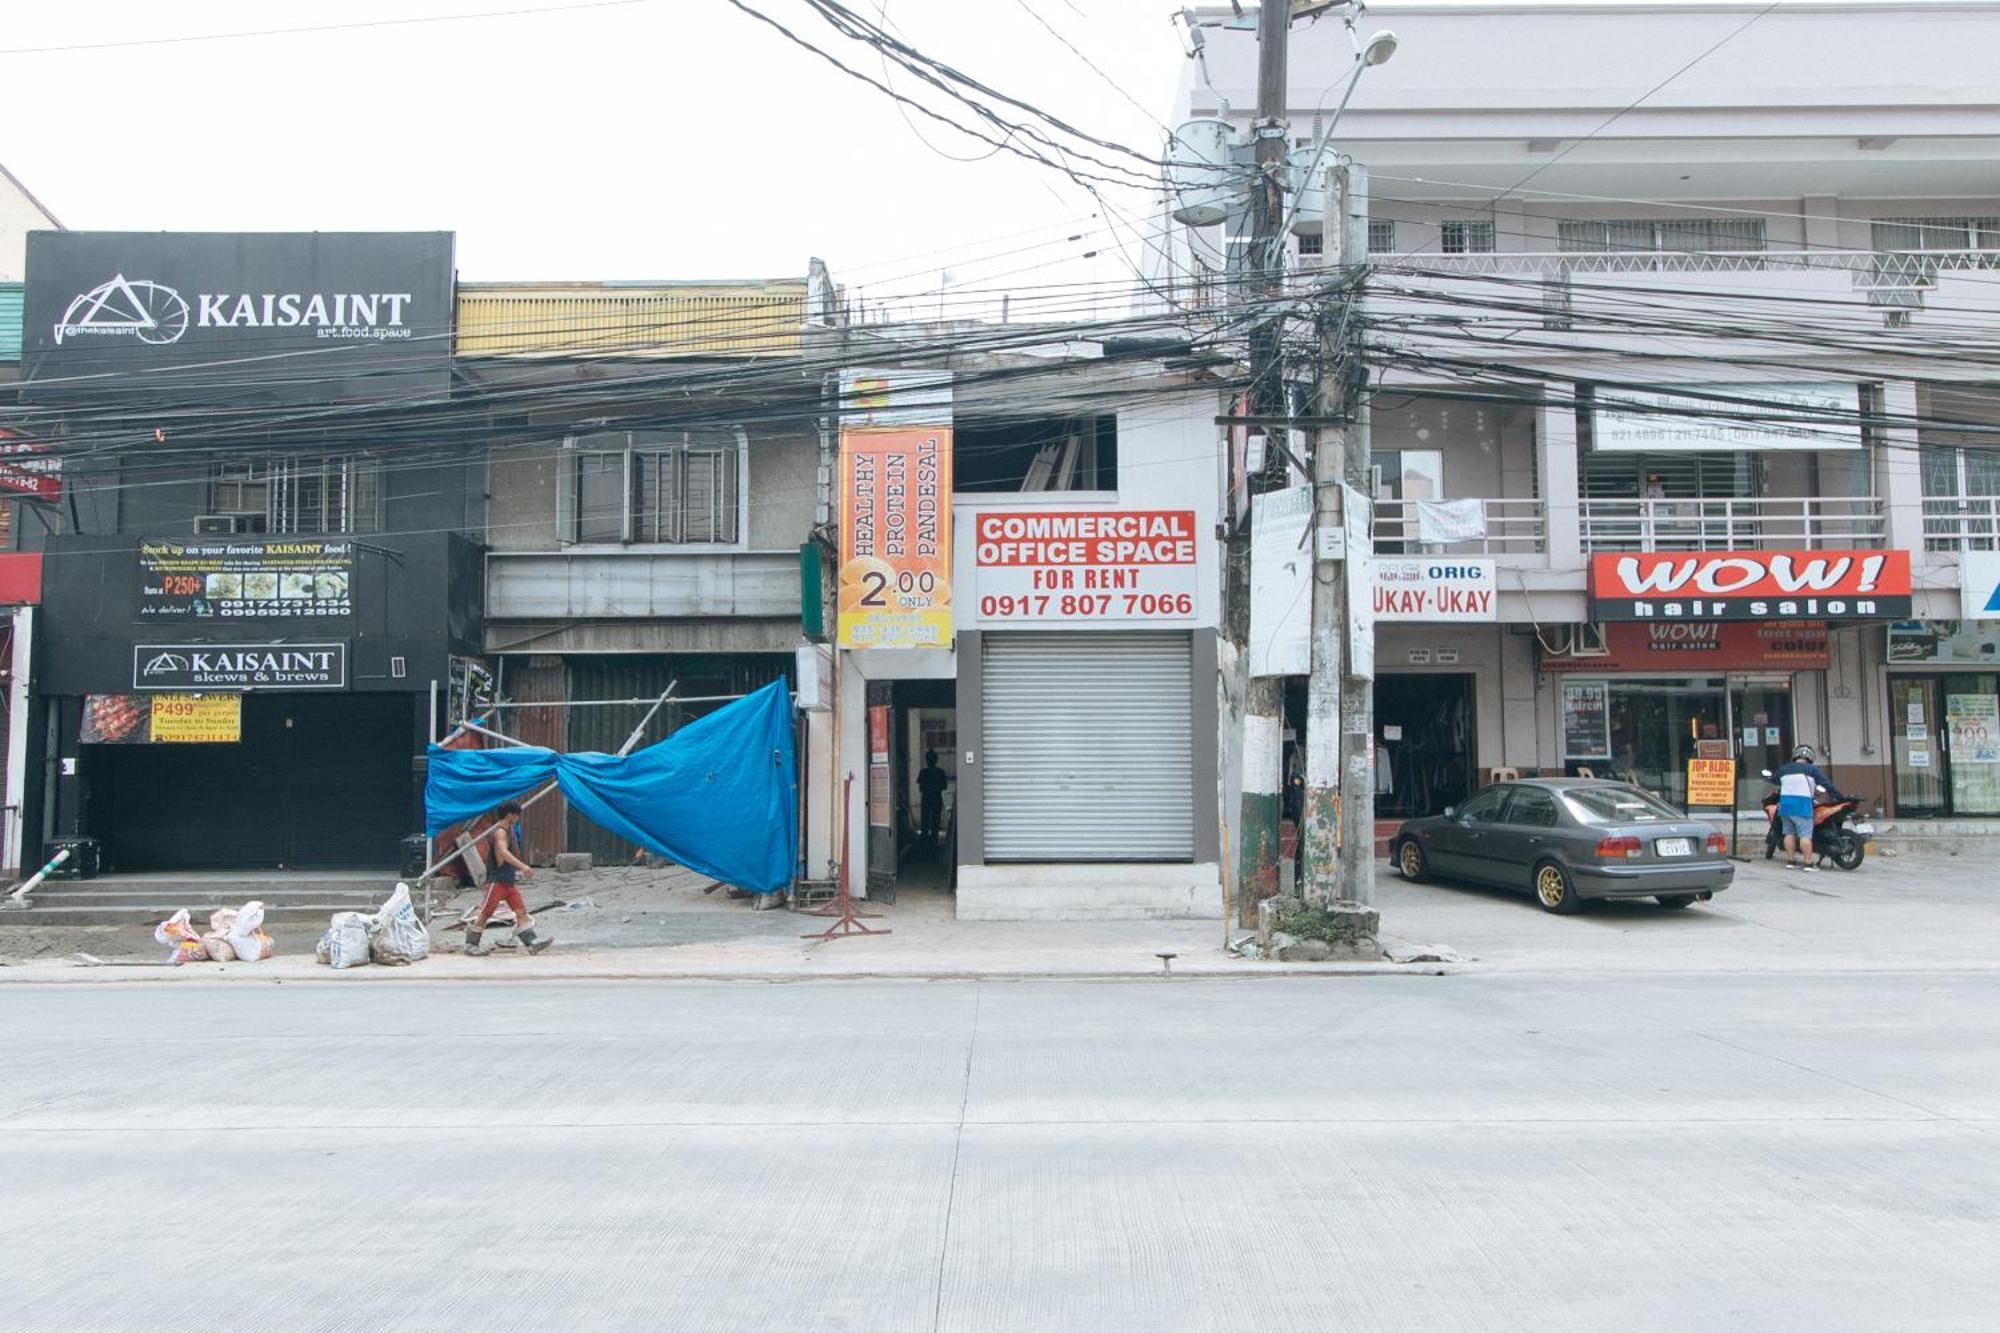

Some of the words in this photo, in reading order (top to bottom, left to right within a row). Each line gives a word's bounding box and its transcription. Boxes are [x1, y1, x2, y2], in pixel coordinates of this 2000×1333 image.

[197, 293, 411, 327] KAISAINT
[316, 326, 411, 340] art.food.space
[856, 454, 874, 556] HEALTHY
[887, 454, 905, 556] PROTEIN
[919, 439, 937, 556] PANDESAL
[982, 516, 1188, 539] COMMERCIAL
[142, 544, 169, 555] Stock
[171, 546, 184, 556] up
[201, 546, 224, 556] your
[226, 544, 263, 555] favorite
[266, 544, 321, 554] KAISAINT
[977, 541, 1088, 564] OFFICE
[1095, 540, 1194, 562] SPACE
[1033, 570, 1074, 589] FOR
[1084, 569, 1140, 588] RENT
[1616, 555, 1888, 595] WOW!
[898, 596, 933, 607] ONLY
[981, 595, 1050, 616] 0917
[1060, 595, 1112, 615] 807
[1122, 594, 1192, 614] 7066
[1634, 600, 1727, 617] hair
[1749, 599, 1876, 616] salon
[1770, 640, 1828, 651] color
[191, 652, 335, 672] KAISAINT
[193, 672, 248, 682] skews
[253, 672, 270, 682] &
[275, 671, 330, 681] brews
[153, 702, 194, 716] P499
